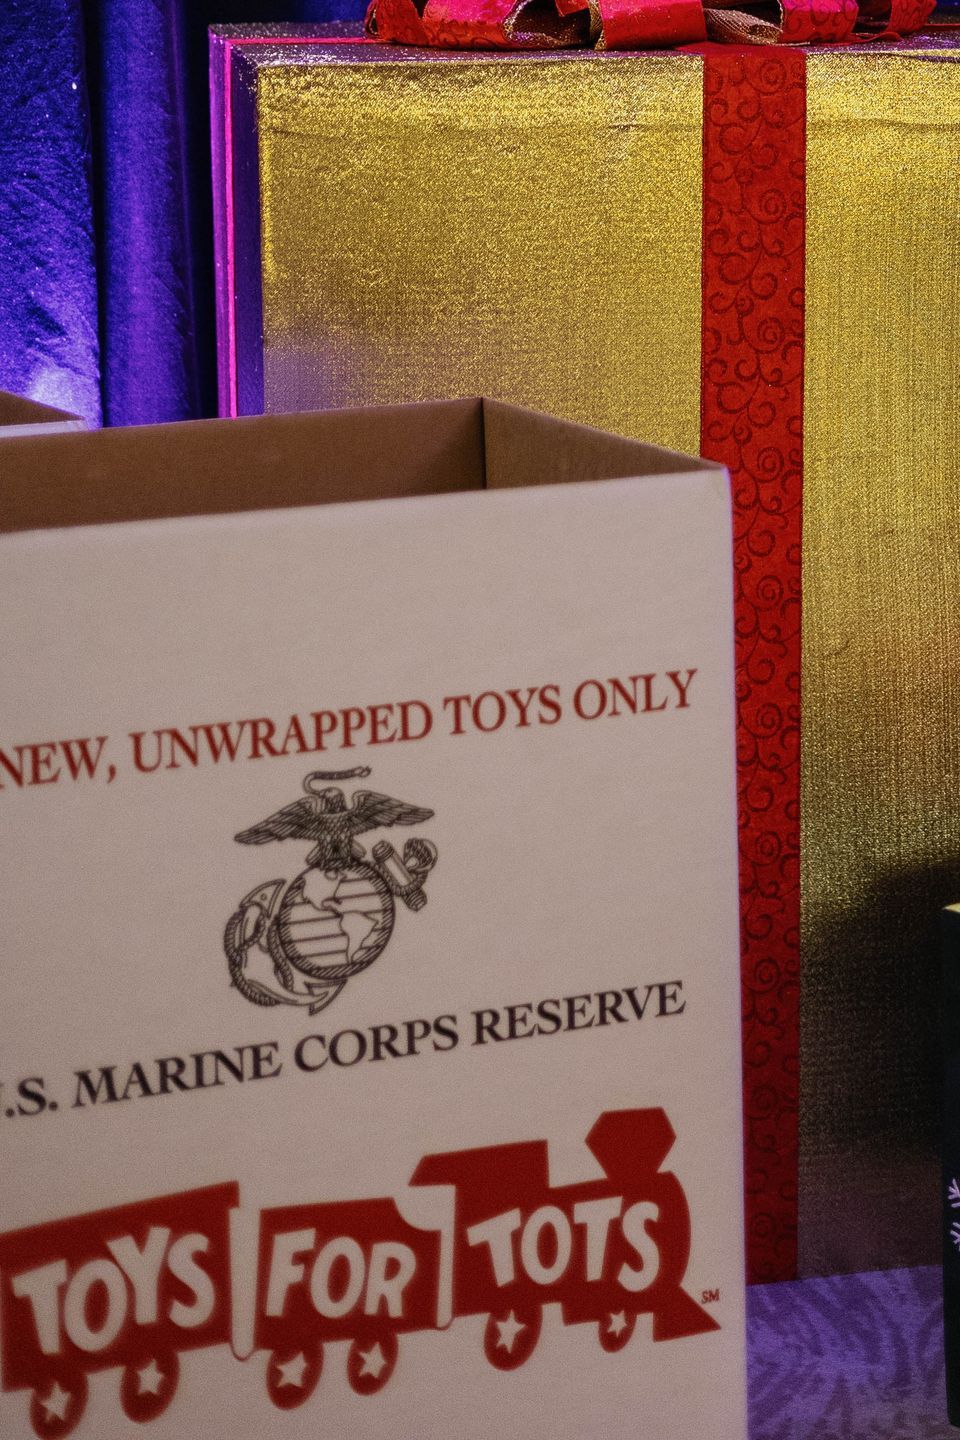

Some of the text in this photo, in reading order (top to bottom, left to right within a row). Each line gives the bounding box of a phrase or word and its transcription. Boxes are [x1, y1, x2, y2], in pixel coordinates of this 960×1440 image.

[0, 668, 698, 790] NEW, UNWRAPPED TOYS ONLY
[0, 980, 687, 1117] .S. MARINE CORPS RESERVE
[11, 1195, 661, 1355] TOYS FOR TOTS
